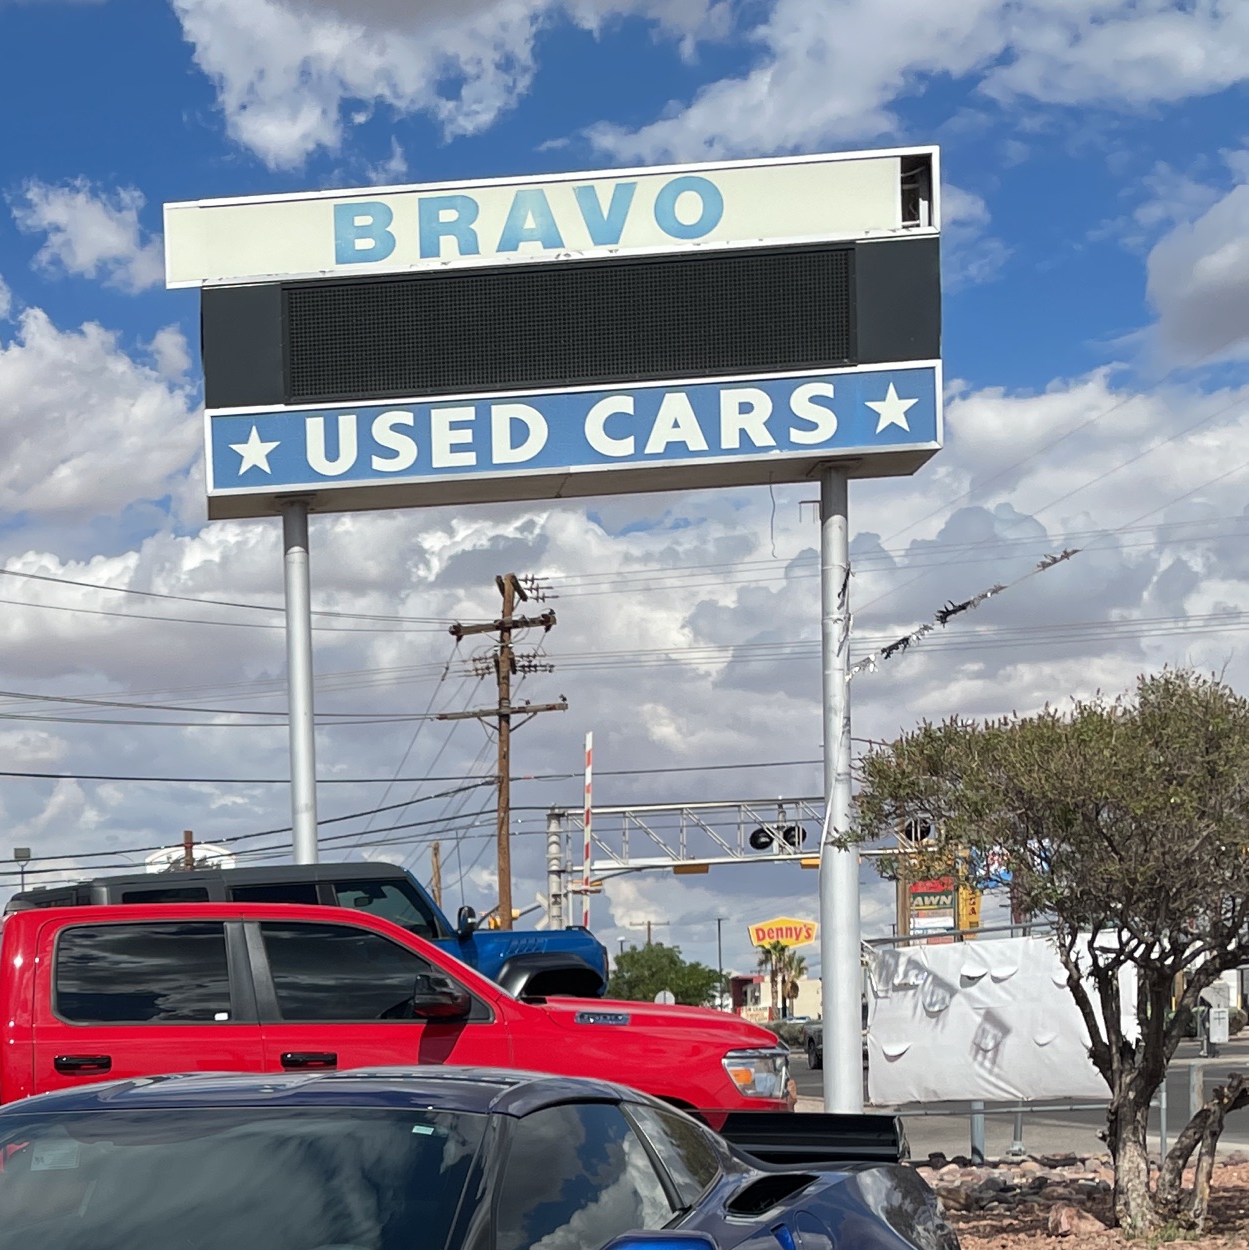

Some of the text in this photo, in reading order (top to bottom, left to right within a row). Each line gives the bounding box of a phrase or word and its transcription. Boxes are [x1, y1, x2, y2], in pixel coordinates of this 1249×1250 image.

[334, 175, 723, 264] BRAVO
[306, 382, 839, 476] USED CARS
[910, 895, 952, 906] AWN
[755, 924, 812, 942] Denny's
